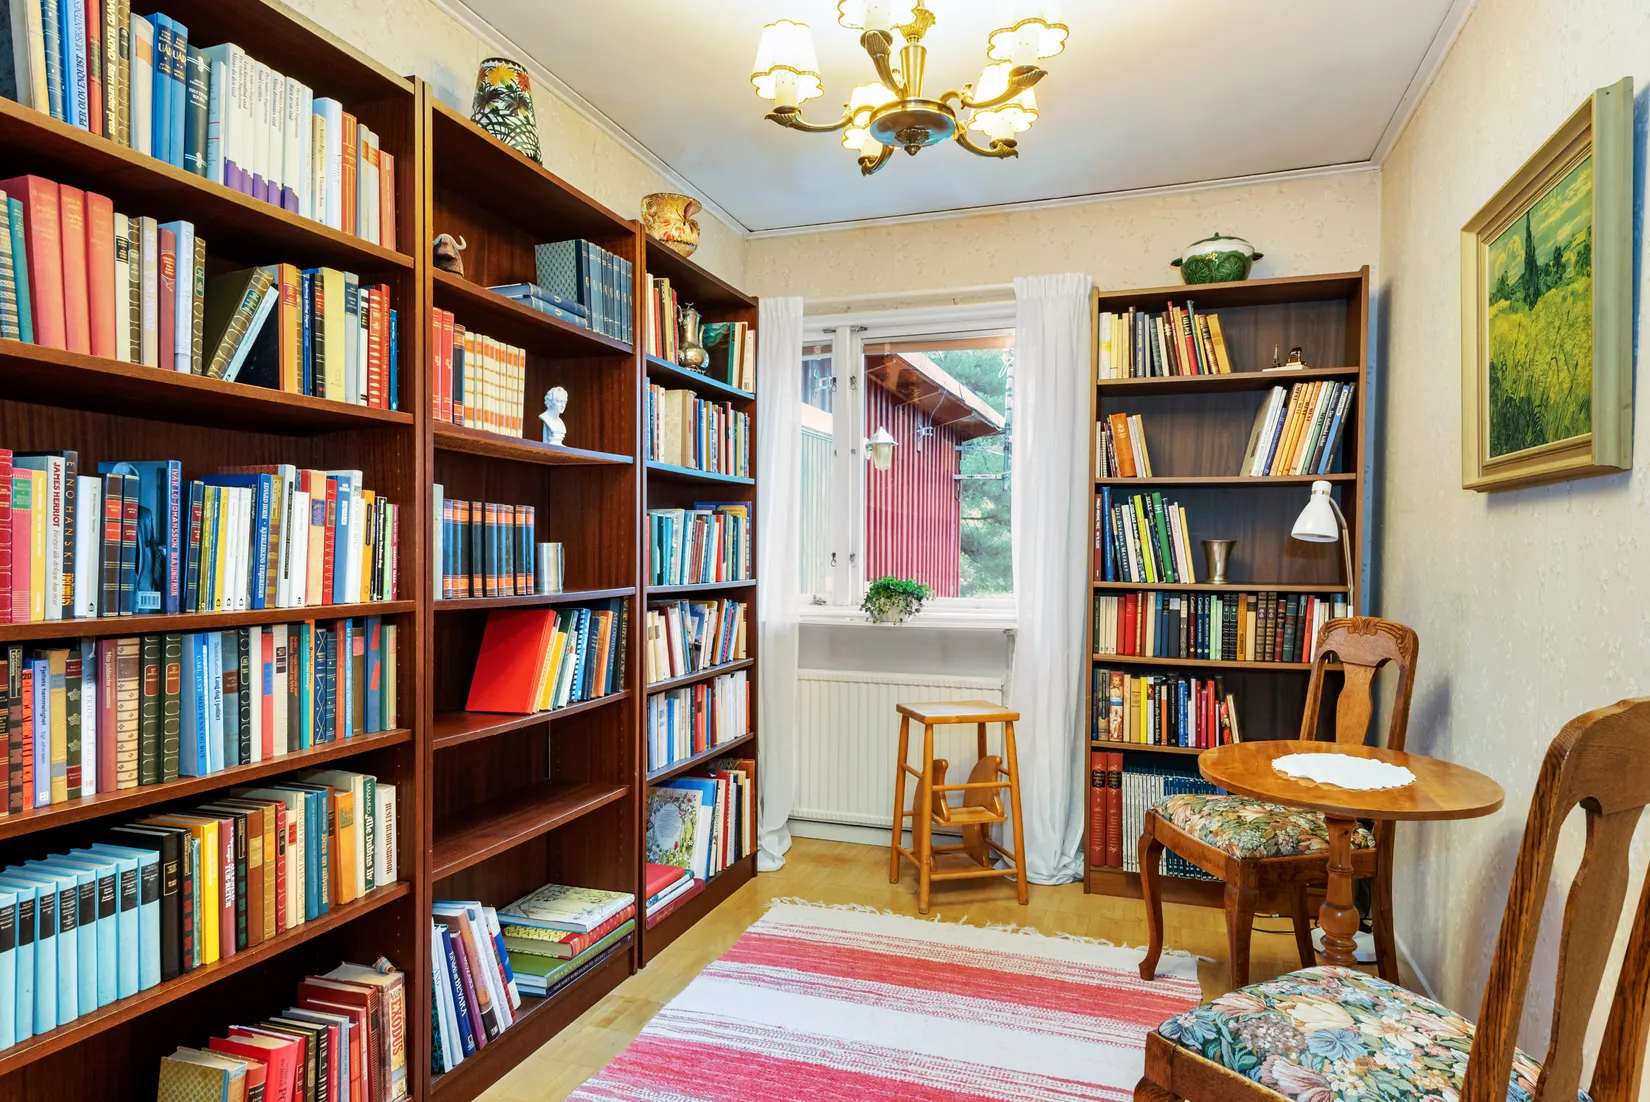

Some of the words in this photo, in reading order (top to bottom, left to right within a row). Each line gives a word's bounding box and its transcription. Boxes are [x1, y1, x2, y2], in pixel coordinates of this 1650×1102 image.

[107, 0, 117, 26] DAVID
[107, 26, 117, 60] ELKIND
[76, 54, 85, 88] ENQUIST
[77, 88, 87, 110] OLOV
[108, 85, 116, 112] under
[78, 111, 88, 127] PER
[106, 110, 116, 135] press
[53, 462, 61, 490] JAMES
[66, 461, 74, 498] EINO
[52, 491, 61, 527] HERRIOT
[170, 489, 178, 548] LO-JOHANSSON
[63, 505, 73, 565] HANSKI
[1116, 520, 1124, 546] SVENSKA
[609, 612, 618, 670] MELODIBOKEN
[22, 672, 32, 681] 20
[199, 733, 204, 743] OG
[365, 814, 374, 833] Alle
[366, 833, 374, 867] Dubins
[366, 867, 374, 880] liv
[454, 978, 468, 1017] BEVARA
[391, 997, 403, 1056] EXODUS
